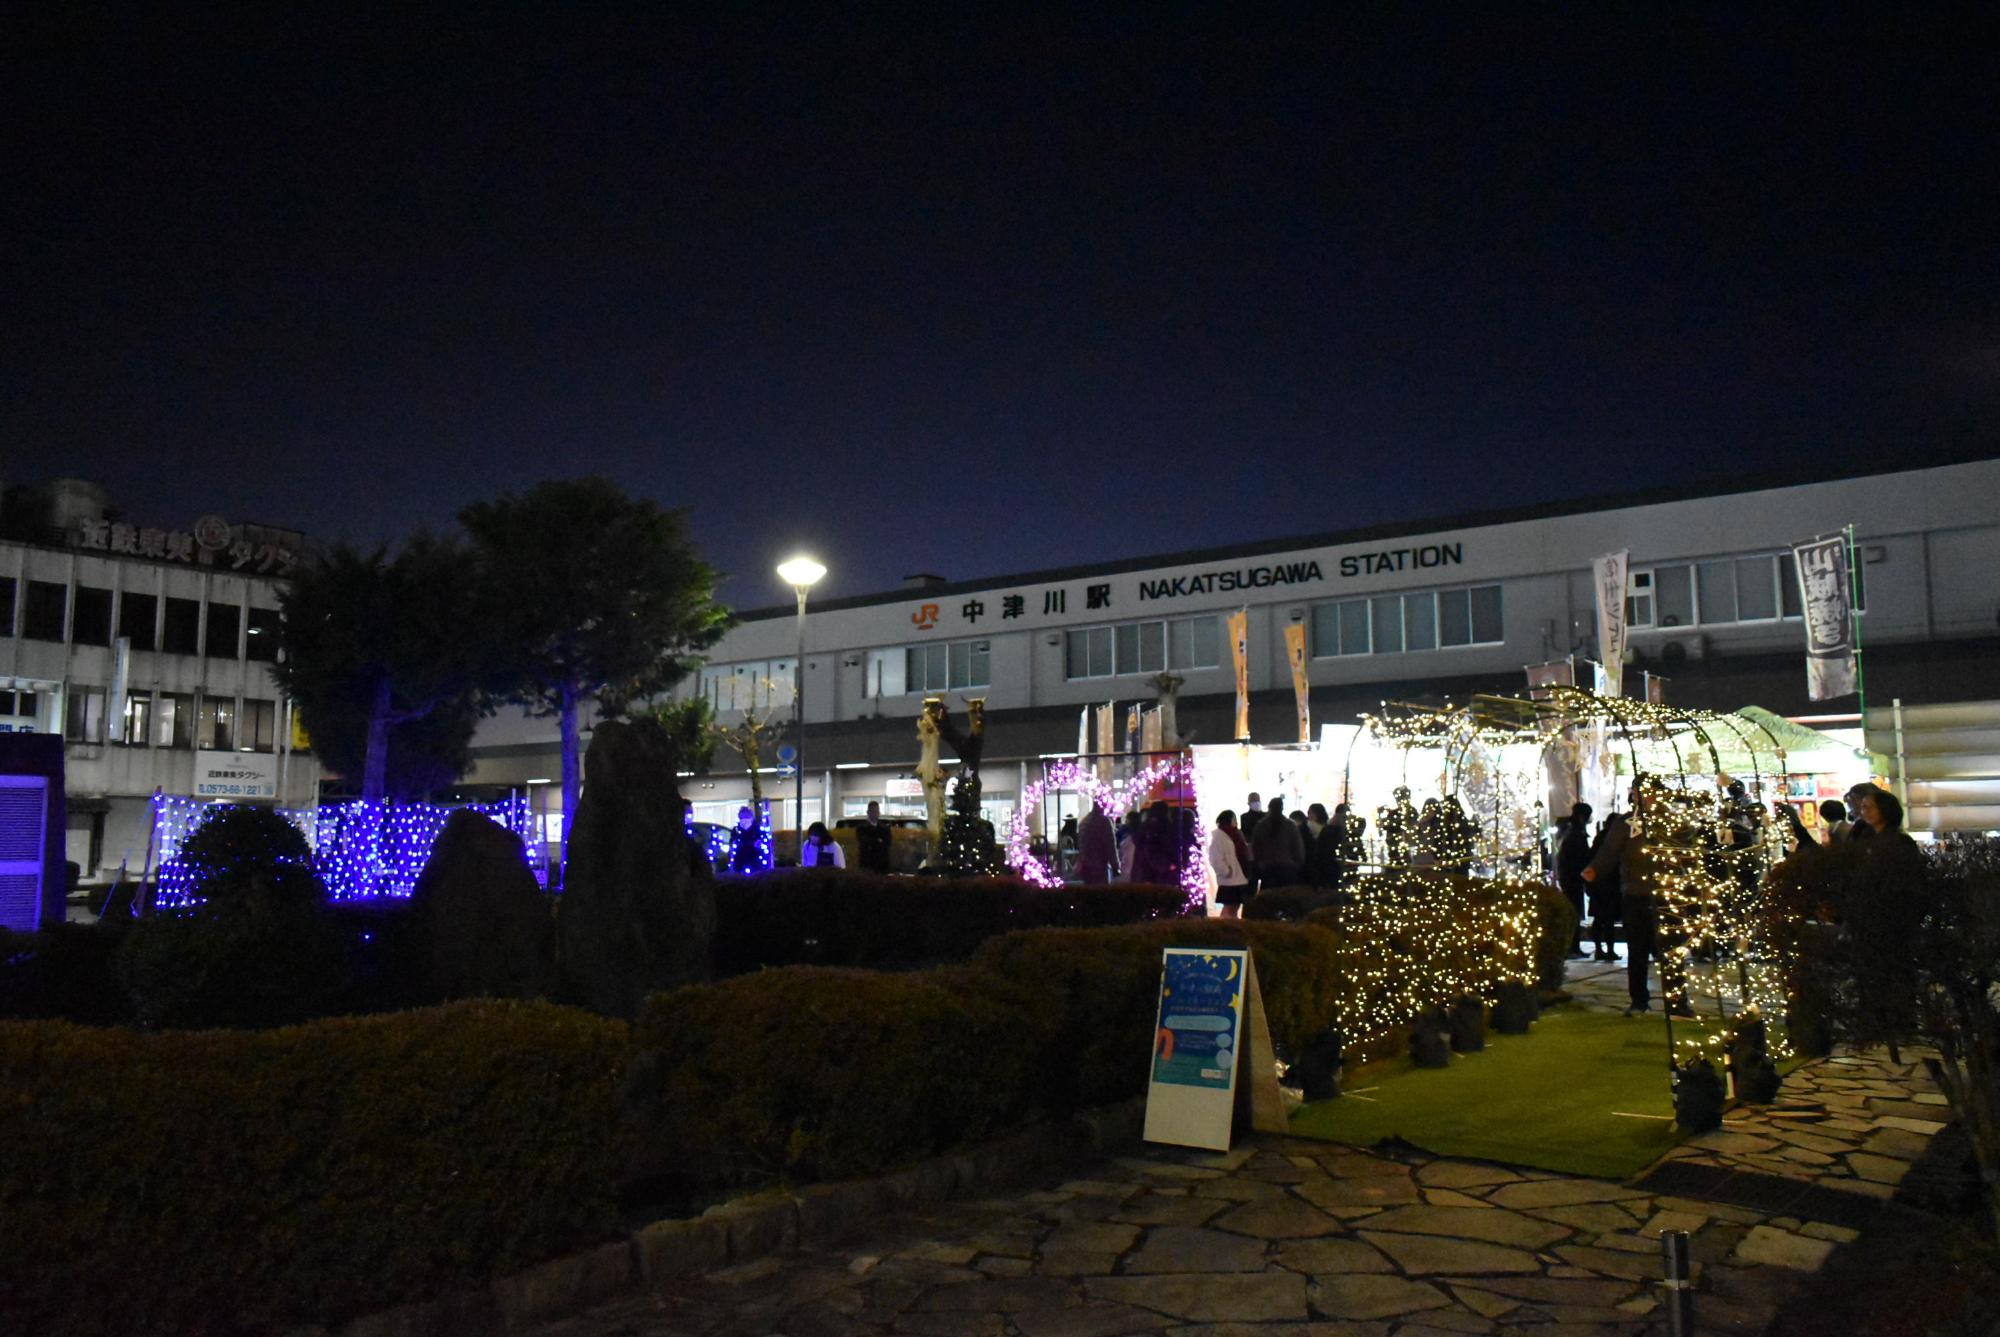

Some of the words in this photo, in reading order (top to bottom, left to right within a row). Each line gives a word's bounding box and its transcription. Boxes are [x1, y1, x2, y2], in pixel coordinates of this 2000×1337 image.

[1139, 560, 1323, 601] NAKATSUGAWA
[1339, 542, 1463, 577] STATION
[911, 603, 940, 625] JR
[962, 583, 1111, 624] 中津川駅
